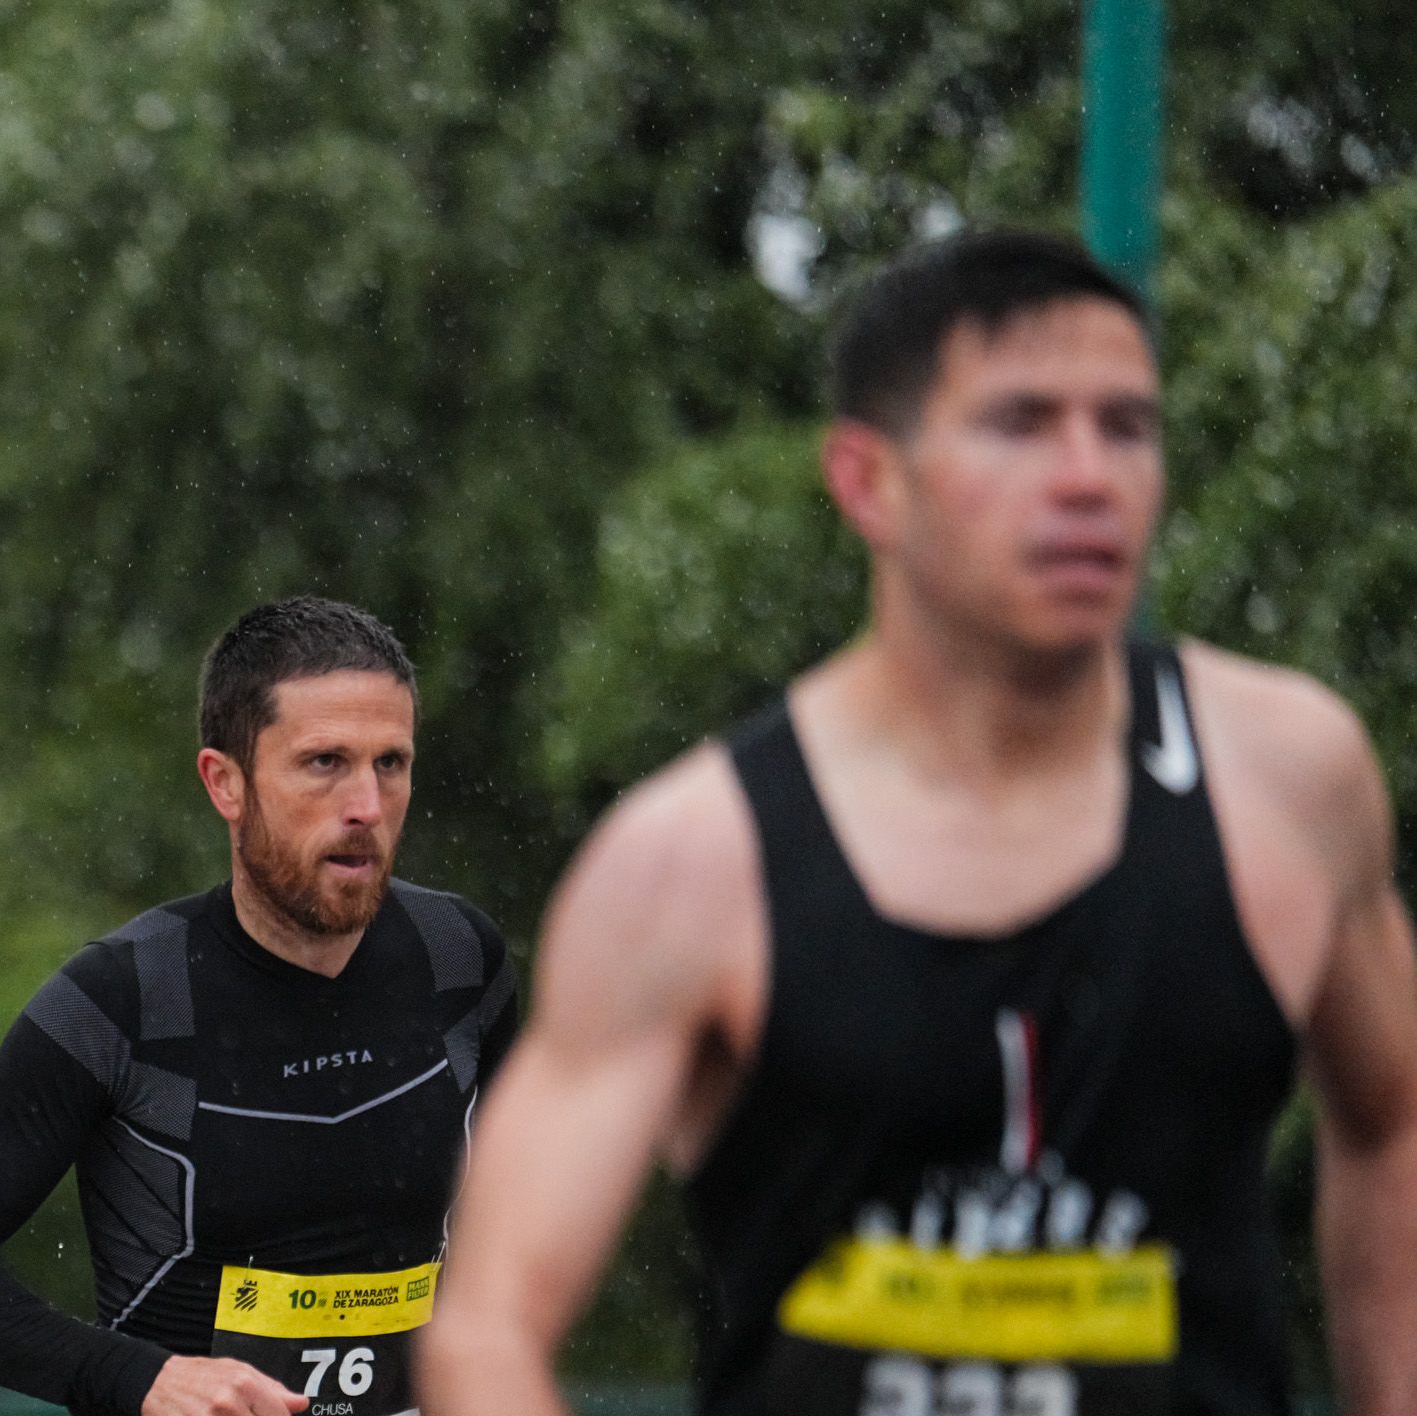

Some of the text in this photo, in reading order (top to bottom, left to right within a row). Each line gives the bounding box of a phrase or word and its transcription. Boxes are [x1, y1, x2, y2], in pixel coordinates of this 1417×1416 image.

[283, 1049, 373, 1078] KIPSTA
[288, 1289, 317, 1310] 10
[335, 1286, 399, 1299] XIX MARATÓN
[333, 1295, 399, 1308] DE ZARAGOZA
[300, 1347, 375, 1398] 76
[311, 1402, 354, 1416] CHUSA
